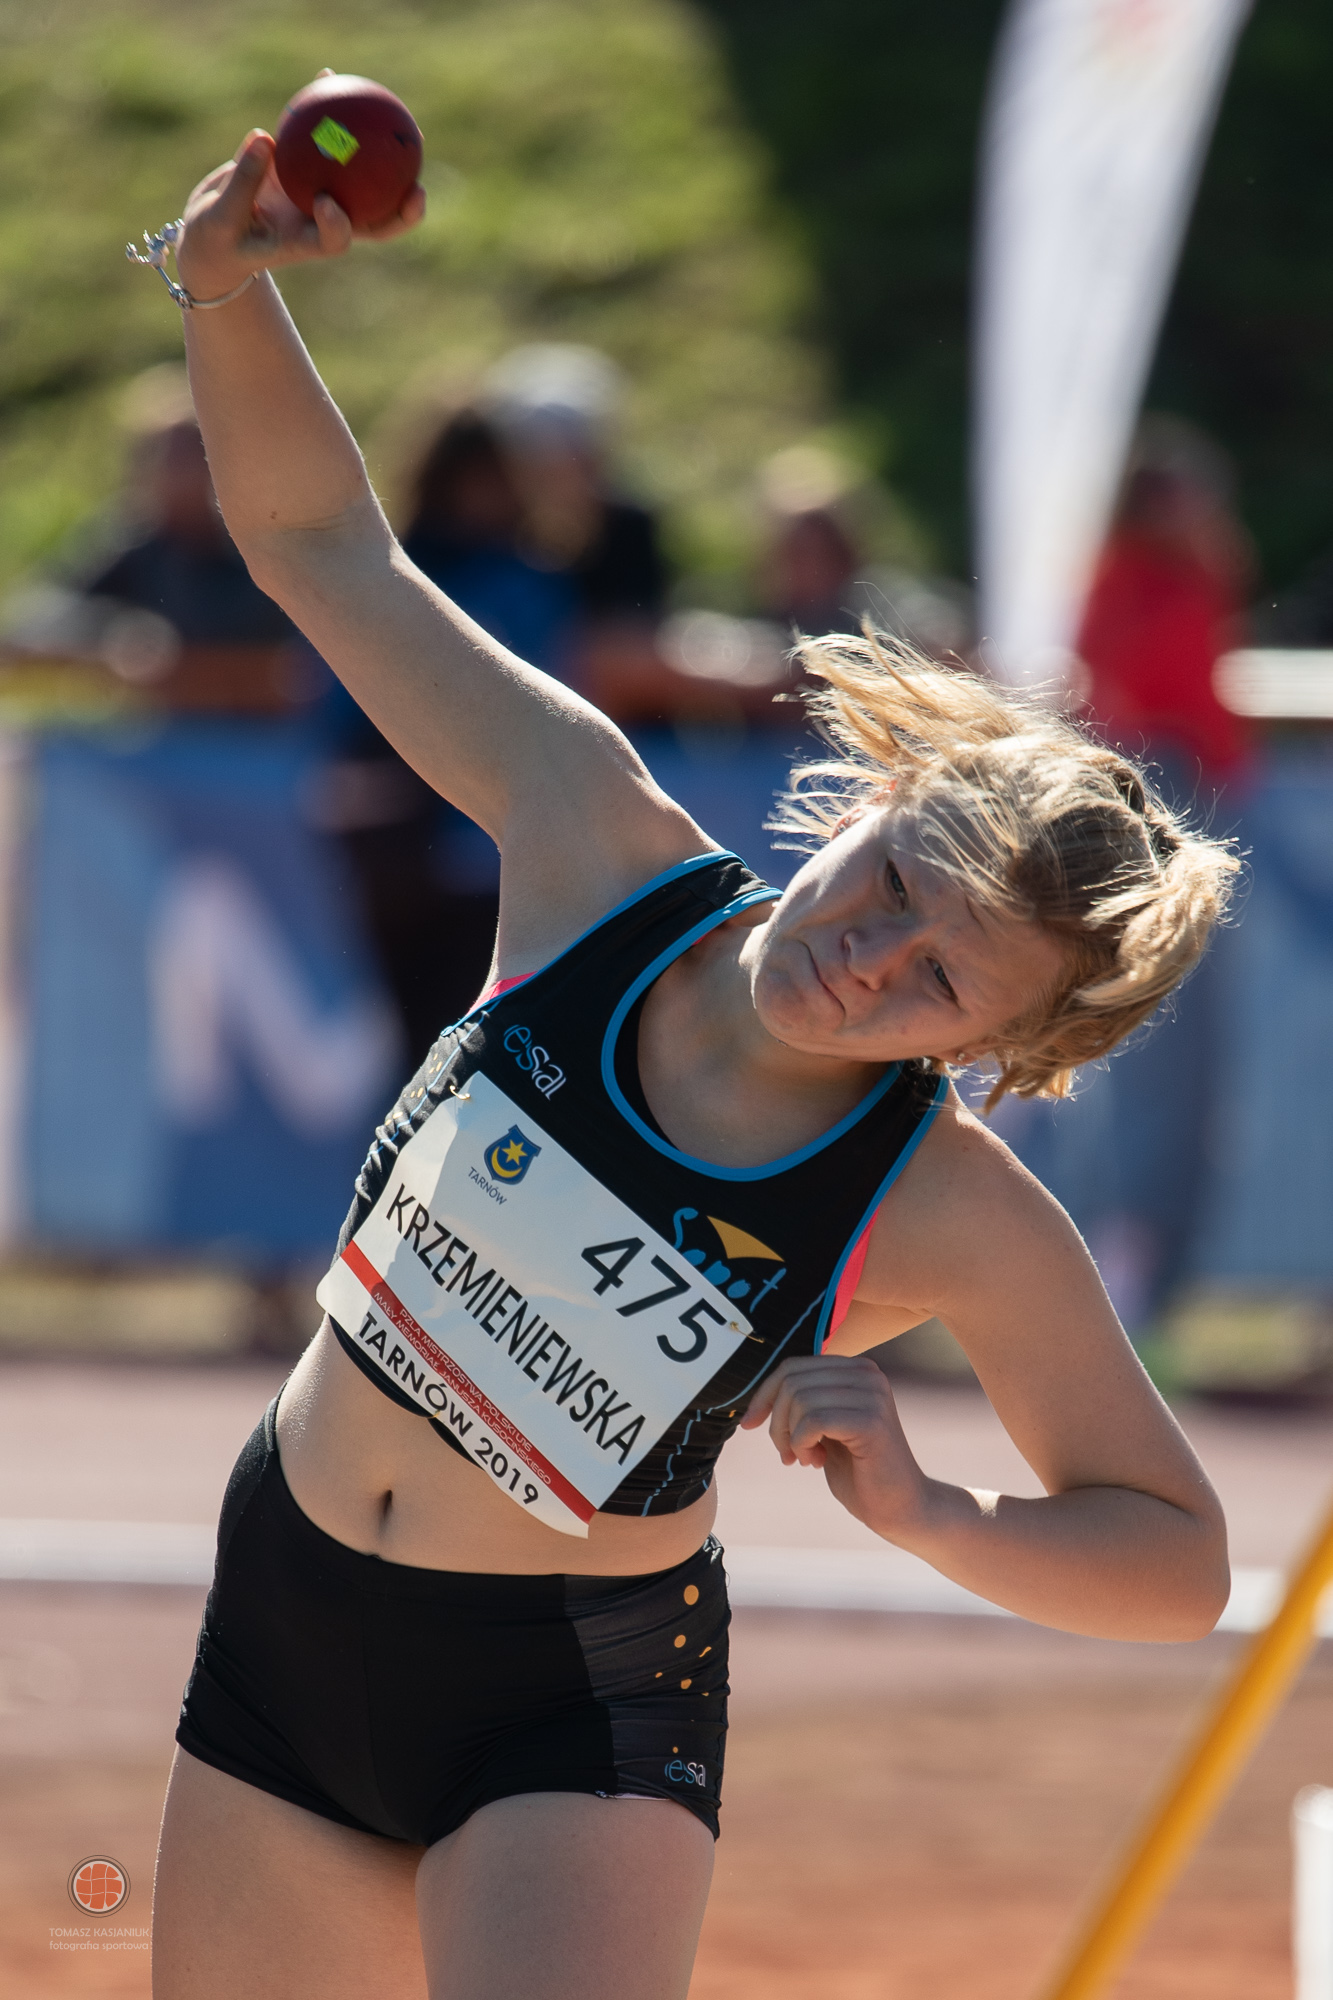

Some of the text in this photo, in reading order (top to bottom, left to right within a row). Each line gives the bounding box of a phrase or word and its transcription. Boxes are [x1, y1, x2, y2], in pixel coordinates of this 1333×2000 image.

[468, 1166, 507, 1206] TARNÓW
[374, 1292, 398, 1320] MAŁY
[396, 1319, 440, 1371] MEMORIAŁ
[438, 1371, 480, 1414] JANUSZA
[386, 1183, 647, 1466] KRZEMIENIEWSKA
[581, 1236, 728, 1363] 475
[359, 1311, 539, 1505] TARNÓW 2019
[400, 1308, 533, 1453] PZLA MISTRZOSTWA POLSKI U16
